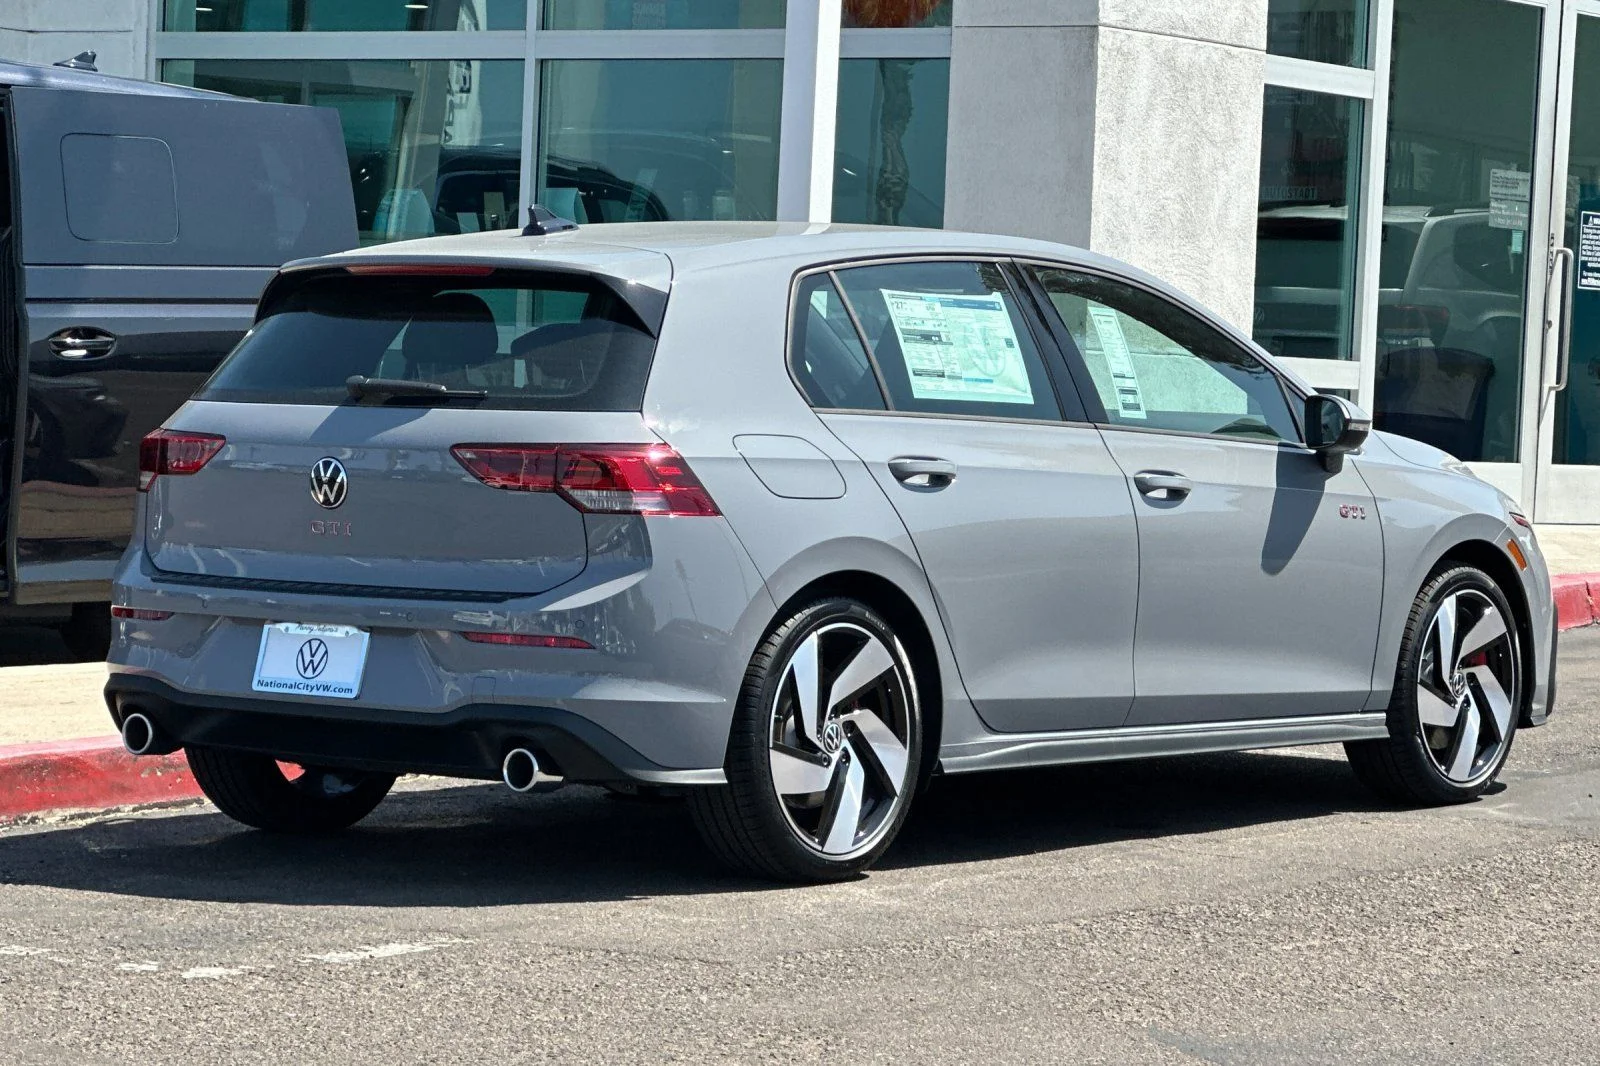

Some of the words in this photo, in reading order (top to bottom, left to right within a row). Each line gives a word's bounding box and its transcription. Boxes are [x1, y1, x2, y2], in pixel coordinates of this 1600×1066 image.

[1339, 504, 1366, 520] GTI
[310, 520, 352, 536] GTI
[256, 679, 353, 694] NationalCityVW.com
